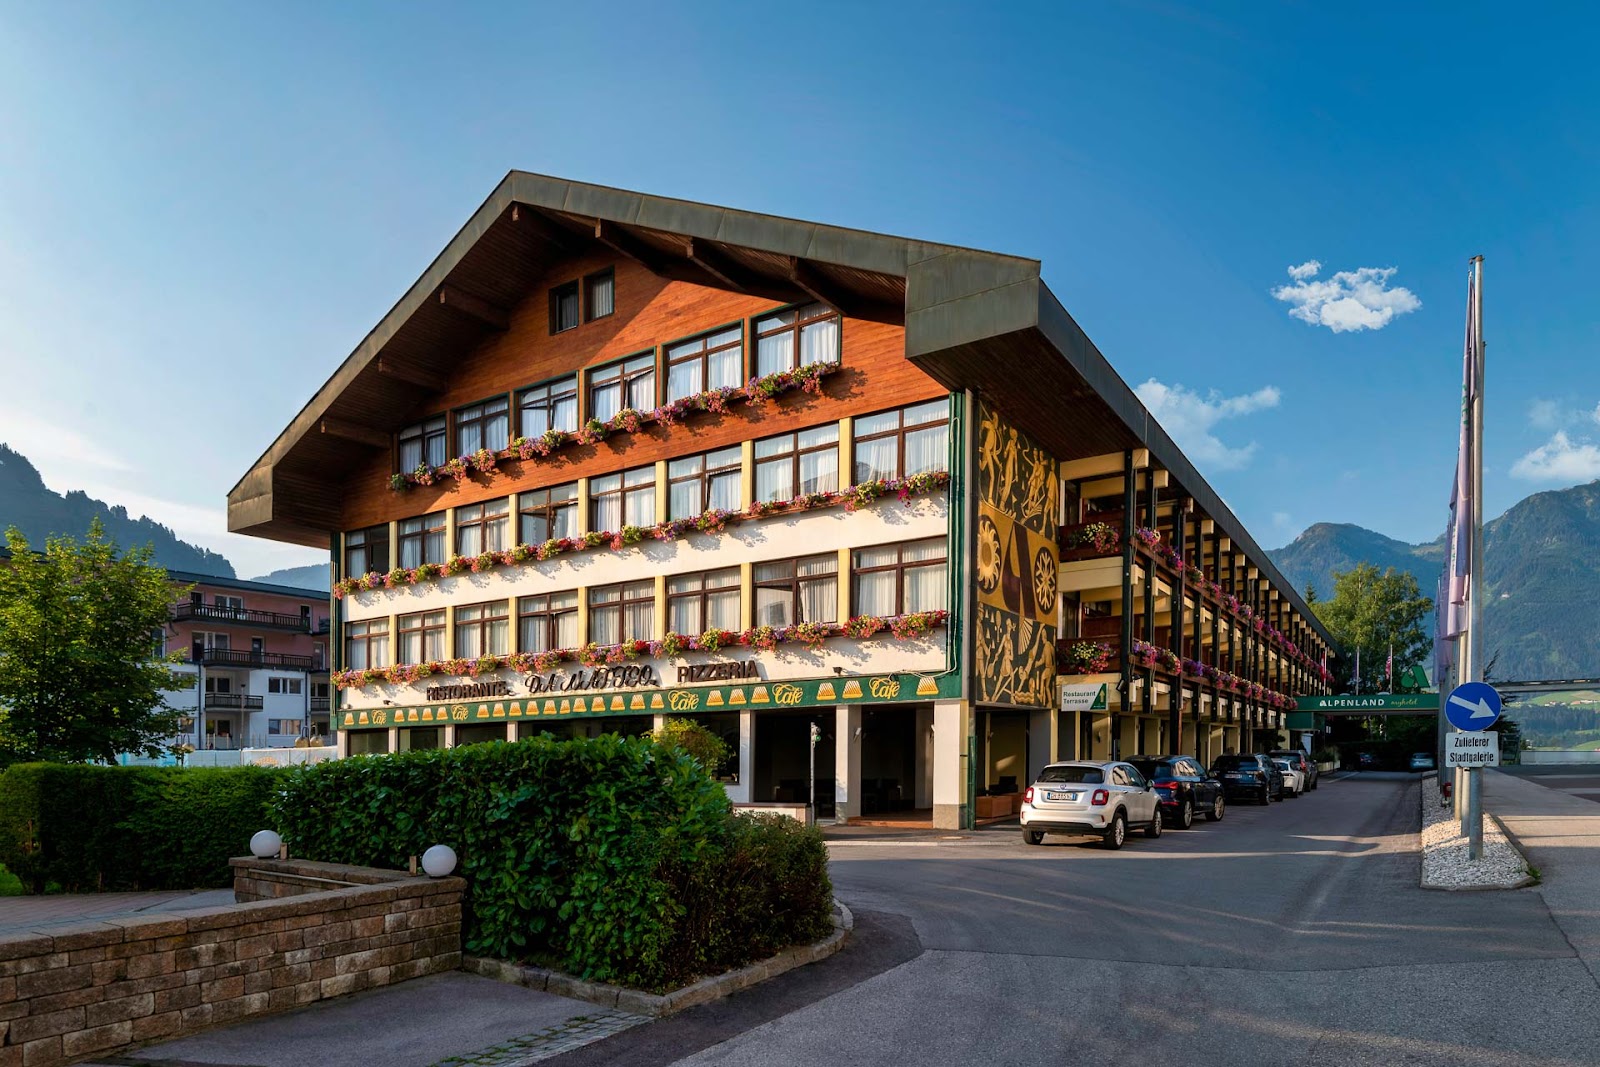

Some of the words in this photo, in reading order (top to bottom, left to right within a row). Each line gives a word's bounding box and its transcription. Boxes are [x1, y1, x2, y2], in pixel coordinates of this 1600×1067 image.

[677, 660, 760, 683] PIZZERIA
[427, 681, 509, 701] RISTORANTE
[1319, 699, 1385, 707] ALPENLAND
[1454, 737, 1490, 748] Zulieferer
[1449, 752, 1494, 763] Stadtgalerie
